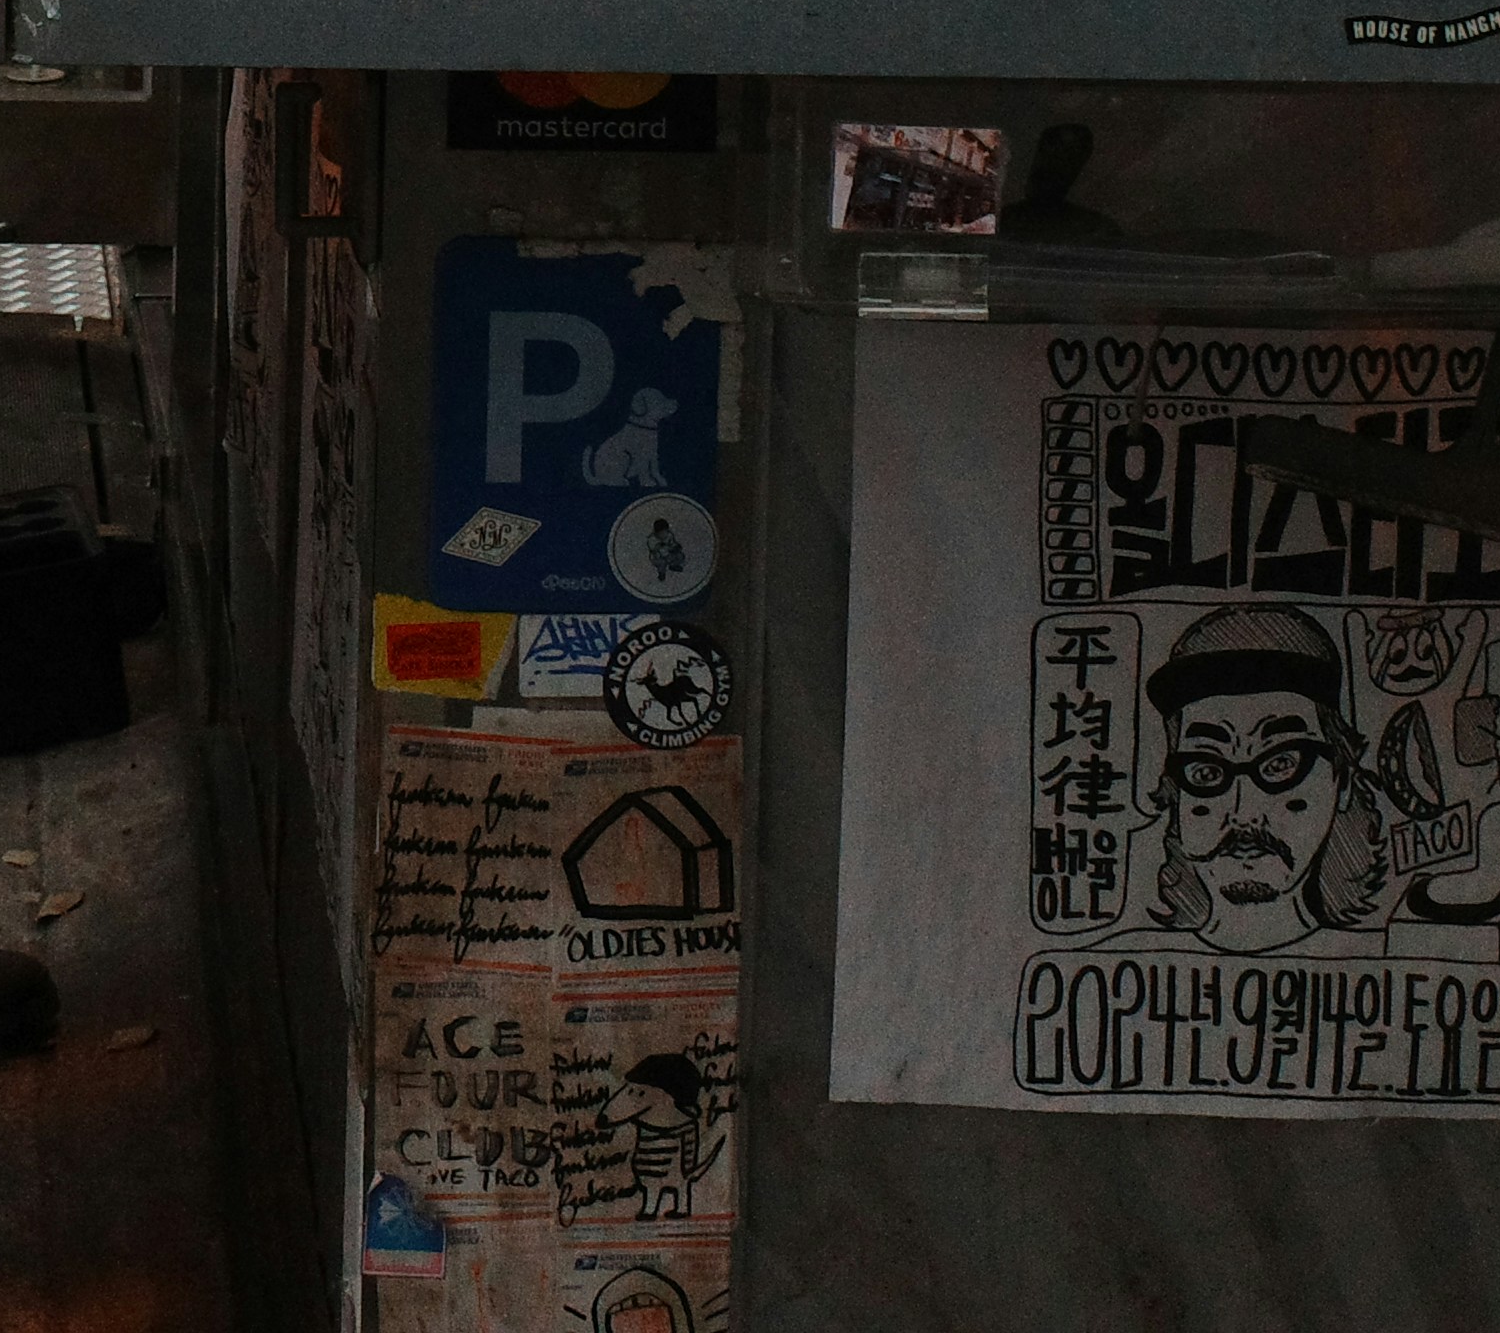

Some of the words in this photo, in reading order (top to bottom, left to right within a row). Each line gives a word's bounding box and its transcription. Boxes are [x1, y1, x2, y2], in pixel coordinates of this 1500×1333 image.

[1352, 21, 1411, 43] HOUSE
[1416, 25, 1440, 45] OF
[496, 117, 668, 140] mastercard
[485, 310, 616, 483] P
[609, 626, 674, 683] NOROO
[637, 709, 722, 749] CLIMBING
[715, 665, 733, 707] GYM
[1038, 624, 1126, 820] 平均律
[1398, 816, 1467, 868] TACO
[402, 1015, 526, 1060] ACE
[393, 1069, 548, 1110] FOUR
[399, 1127, 551, 1167] CLUB
[480, 1168, 540, 1191] TACO
